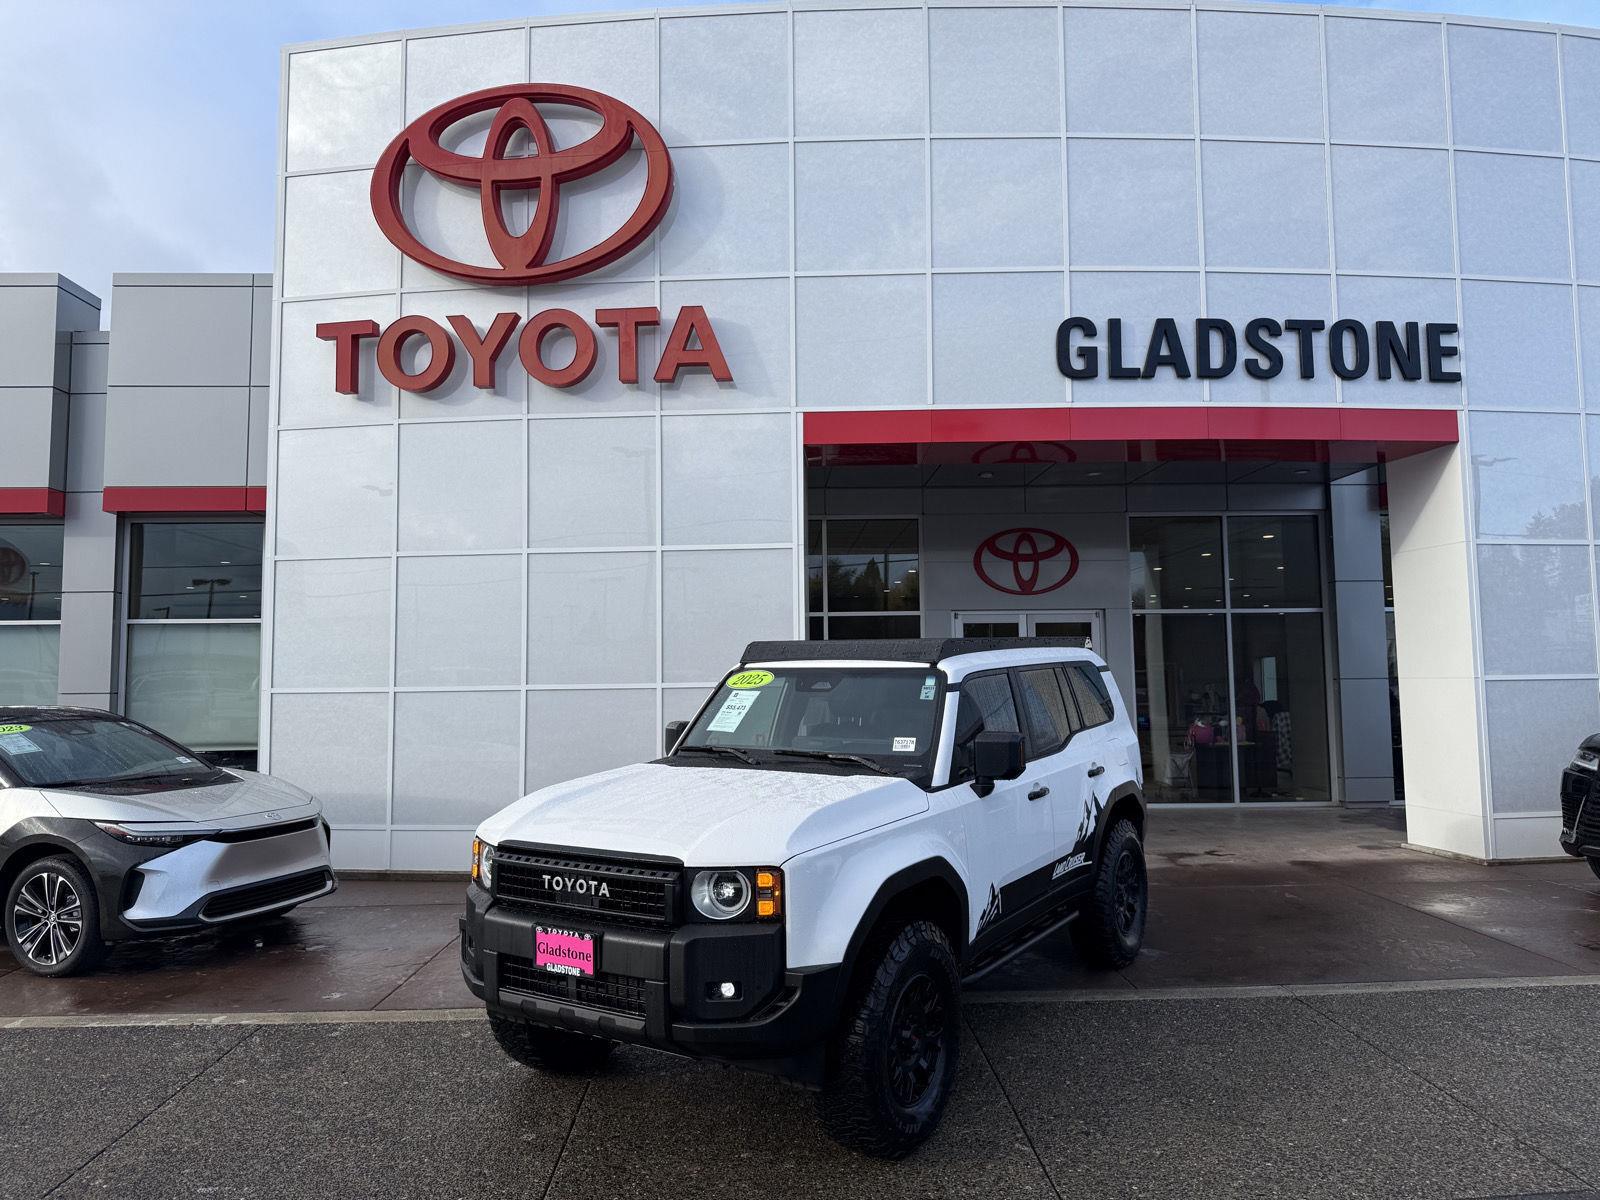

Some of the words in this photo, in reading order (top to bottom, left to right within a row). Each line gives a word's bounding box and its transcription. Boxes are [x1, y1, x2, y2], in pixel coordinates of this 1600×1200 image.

[316, 305, 734, 396] TOYOTA
[1056, 316, 1462, 383] GLADSTONE
[731, 674, 768, 686] 2025
[542, 874, 610, 897] TOYOTA
[547, 927, 579, 938] TOYOTA
[537, 941, 592, 962] Gladstone
[546, 962, 581, 976] GLADSTONE
